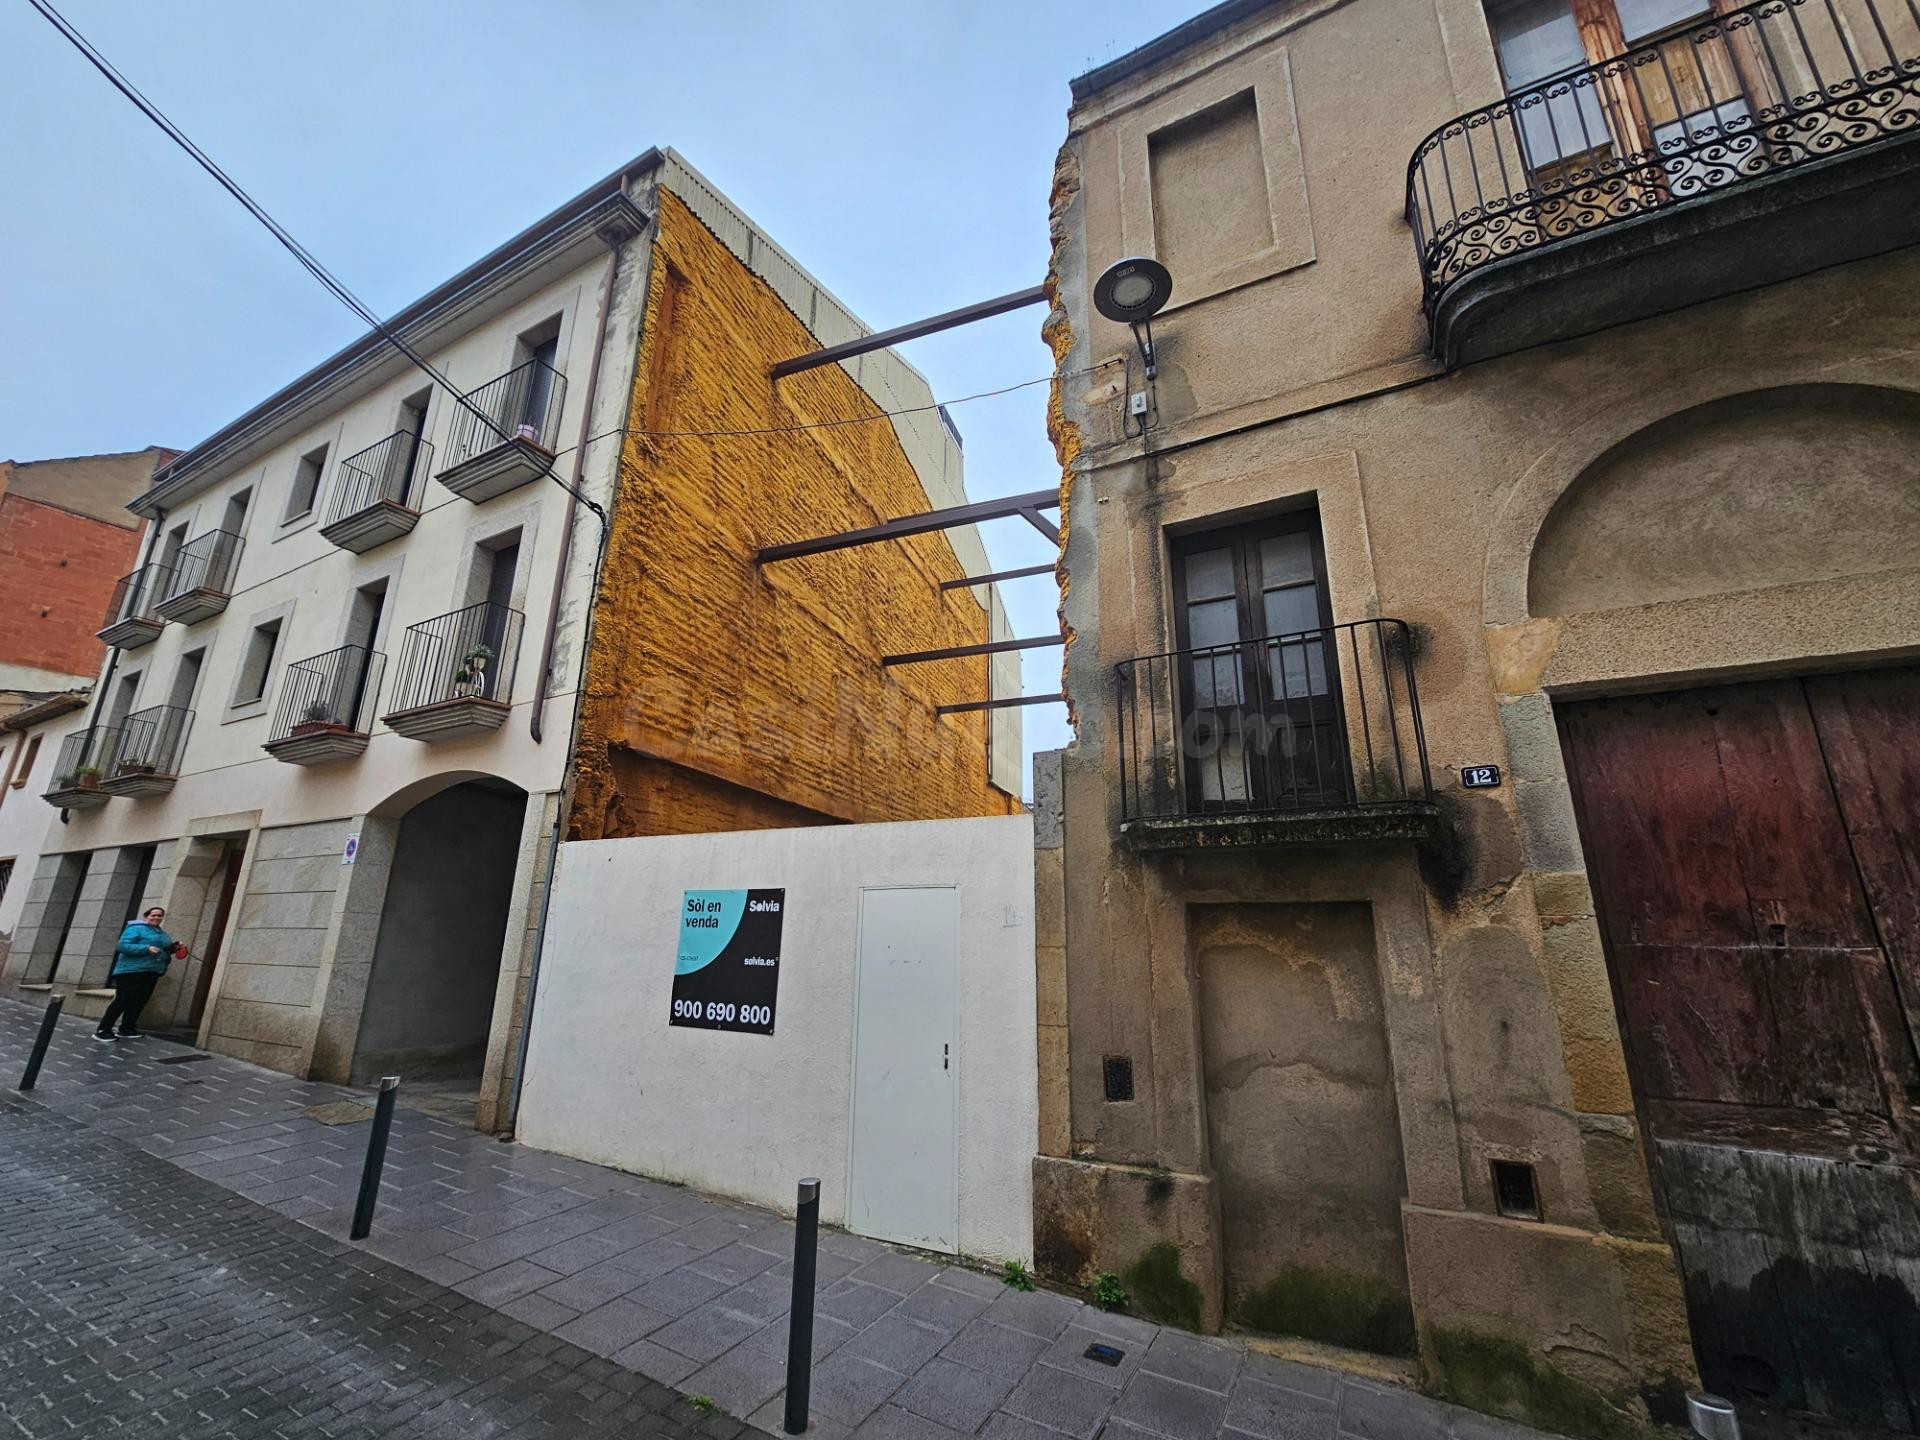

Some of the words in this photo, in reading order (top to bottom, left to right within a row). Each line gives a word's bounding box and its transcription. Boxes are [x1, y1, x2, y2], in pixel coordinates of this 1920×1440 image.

[1470, 769, 1492, 784] 12
[707, 901, 721, 913] en
[749, 900, 780, 912] Solvia
[685, 915, 719, 928] venda
[744, 957, 775, 966] solvia.es
[673, 999, 702, 1019] 900
[706, 1002, 736, 1022] 690
[739, 1004, 771, 1025] 800
